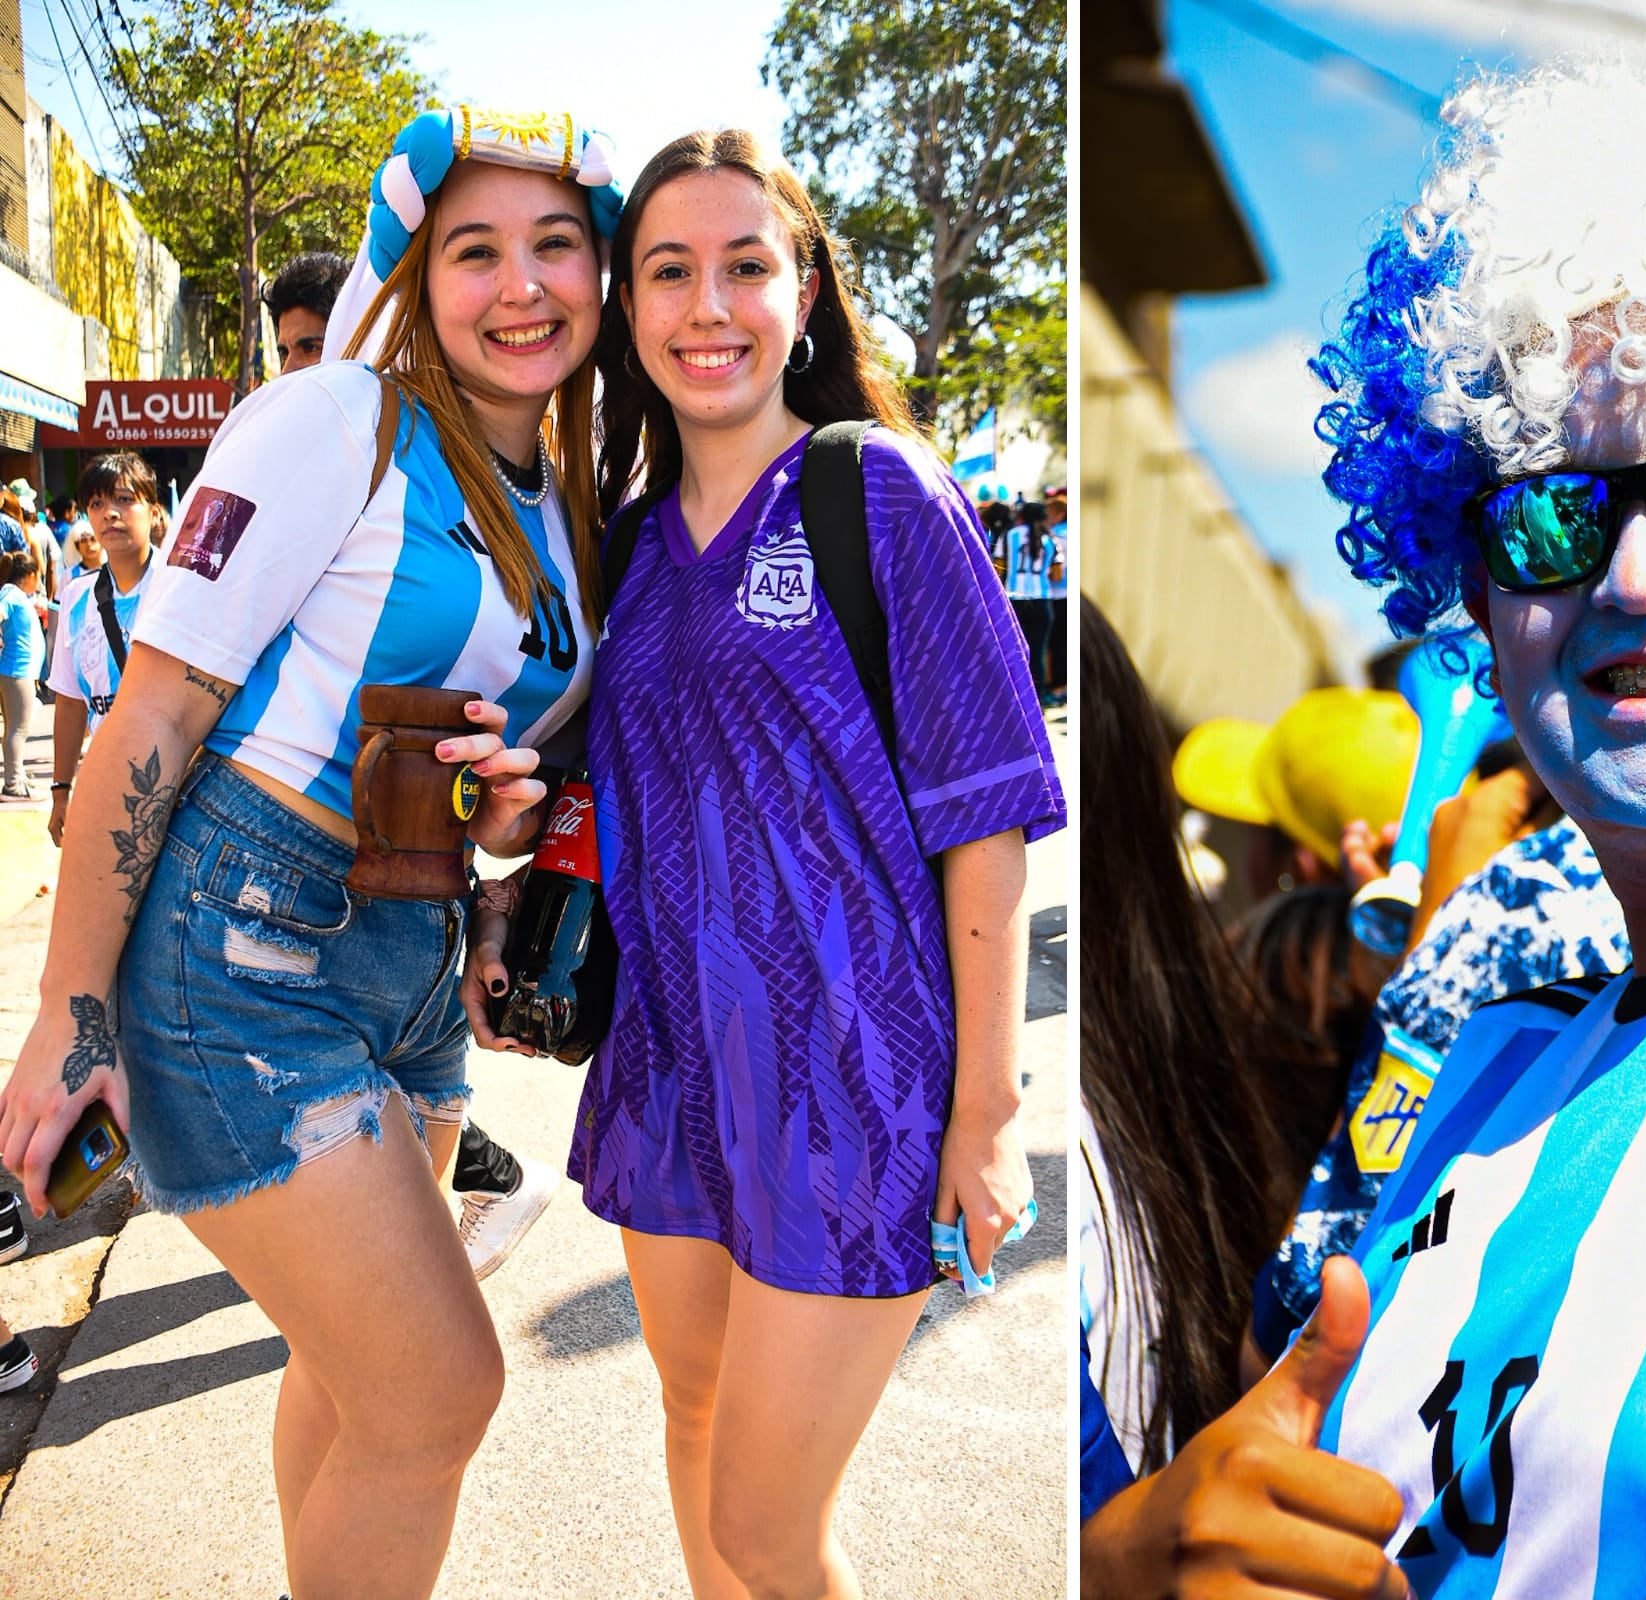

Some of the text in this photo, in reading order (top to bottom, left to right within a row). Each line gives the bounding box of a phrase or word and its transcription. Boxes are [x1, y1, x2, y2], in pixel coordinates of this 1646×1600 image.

[93, 389, 234, 429] ALQUIL
[753, 563, 808, 605] AFA
[518, 577, 578, 673] 10
[1395, 1354, 1539, 1559] 10
